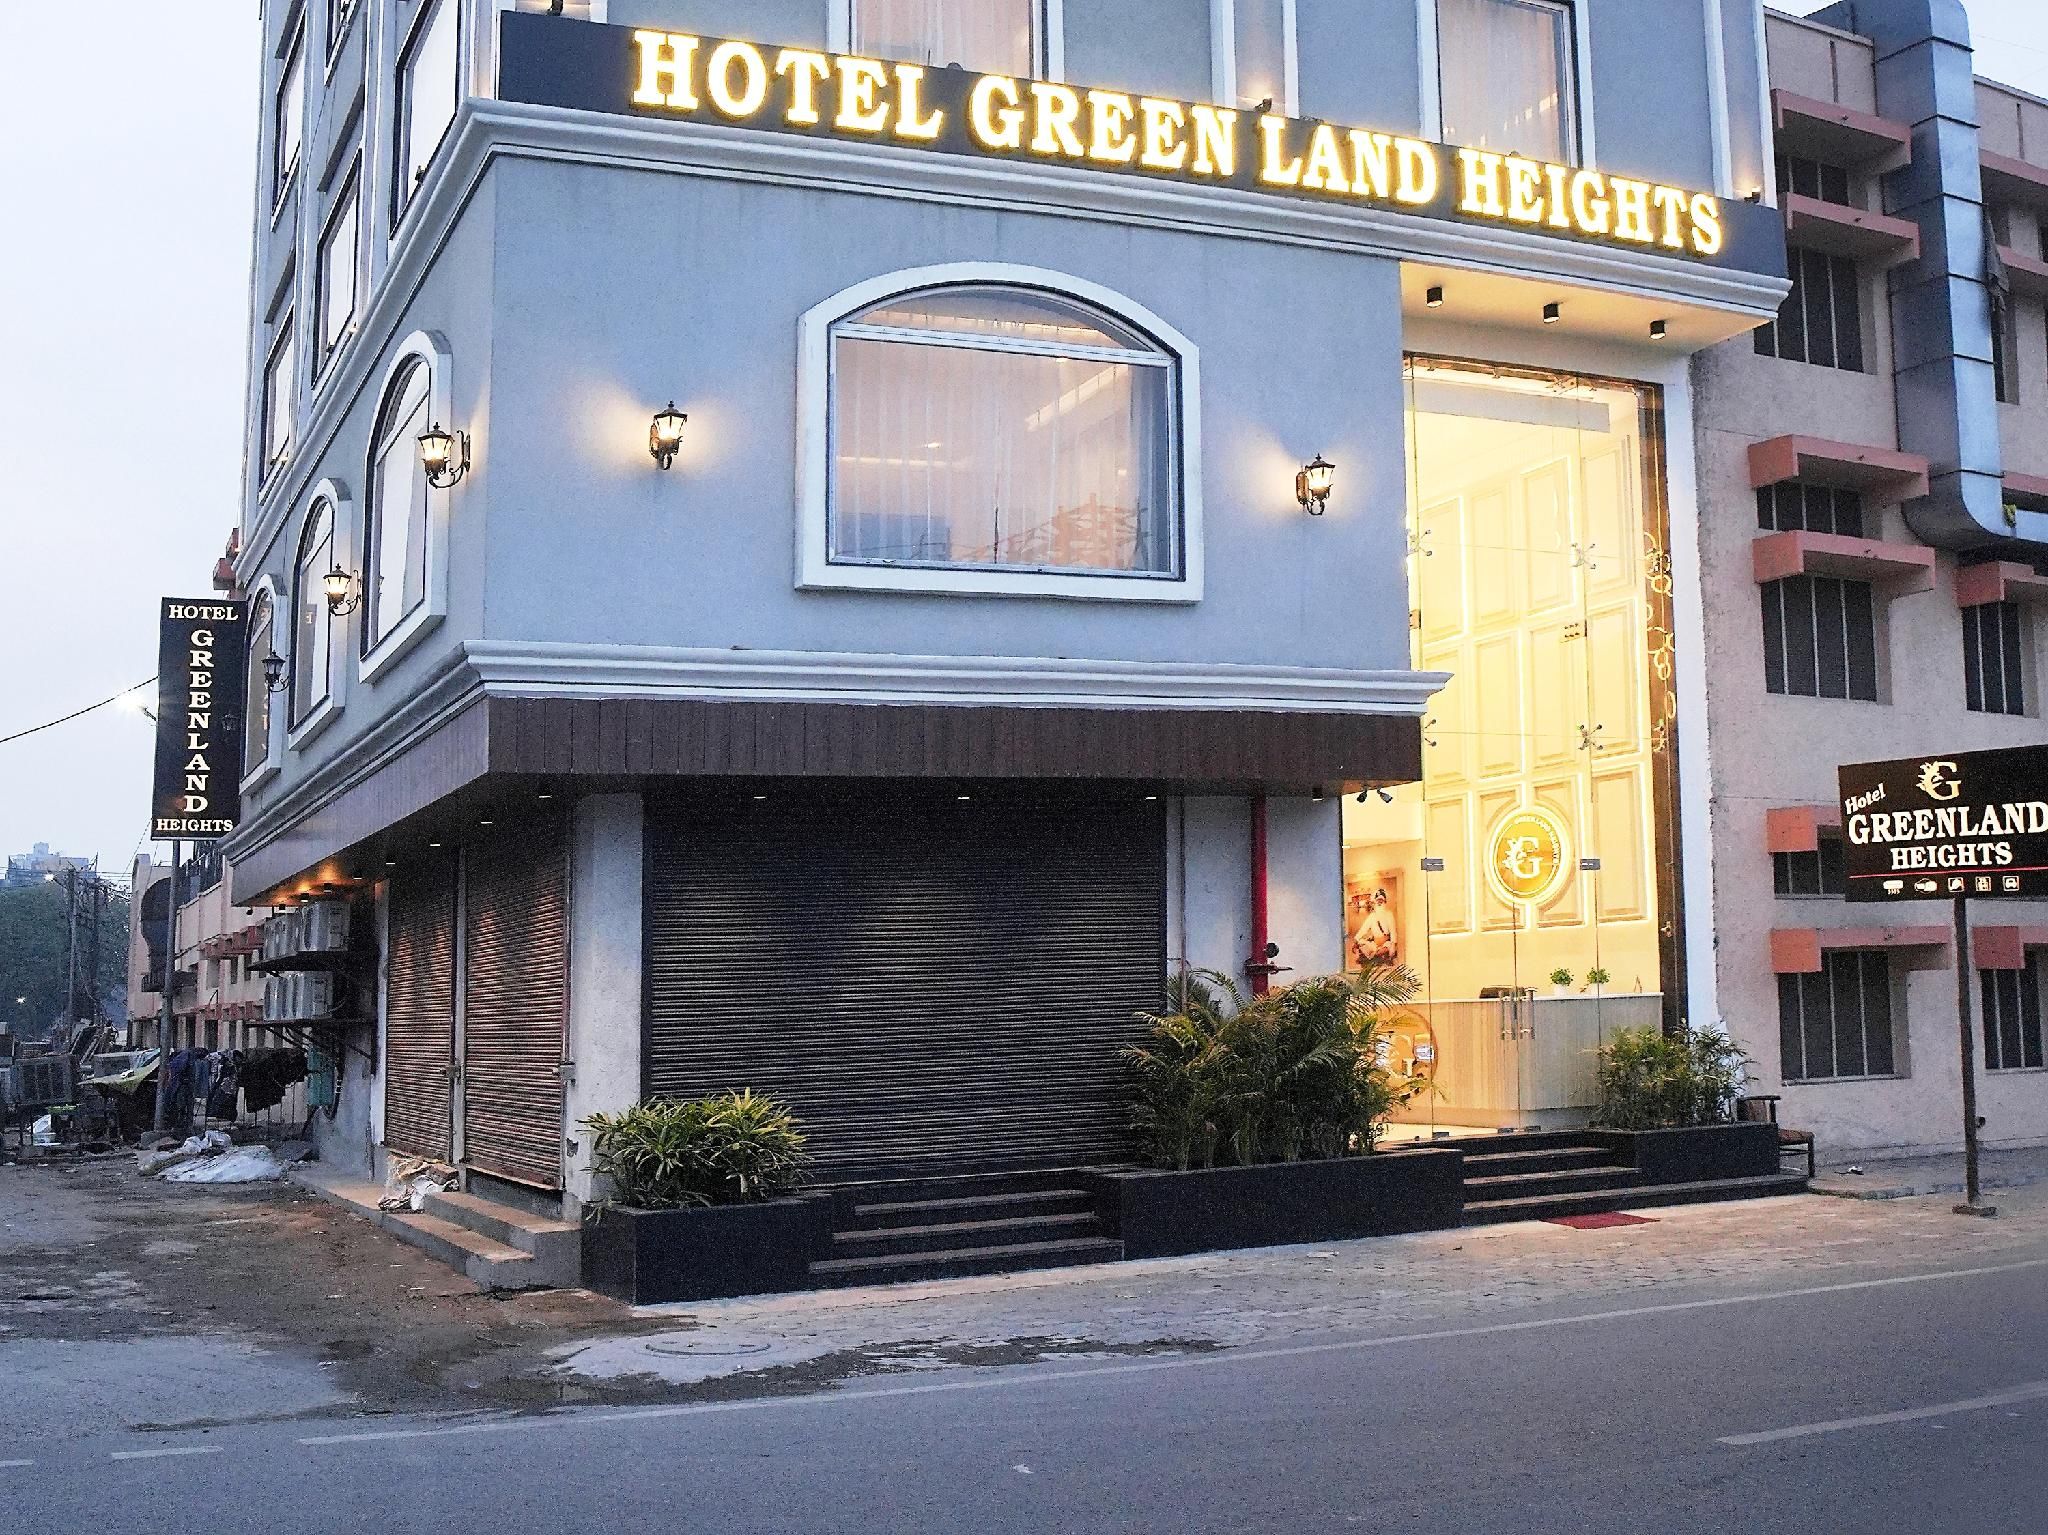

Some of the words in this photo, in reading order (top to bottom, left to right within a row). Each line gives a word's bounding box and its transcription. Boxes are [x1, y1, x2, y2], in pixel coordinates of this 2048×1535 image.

[631, 29, 944, 138] HOTEL
[968, 75, 1237, 176] GREEN
[1260, 115, 1438, 204] LAND
[1459, 147, 1723, 255] HEIGHTS
[168, 604, 239, 621] HOTEL
[183, 629, 215, 813] GREENLAND
[1844, 782, 1886, 815] Hotel
[155, 818, 234, 832] HEIGHTS
[1848, 801, 2048, 845] GREENLAND
[1890, 841, 2013, 870] HEIGHTS
